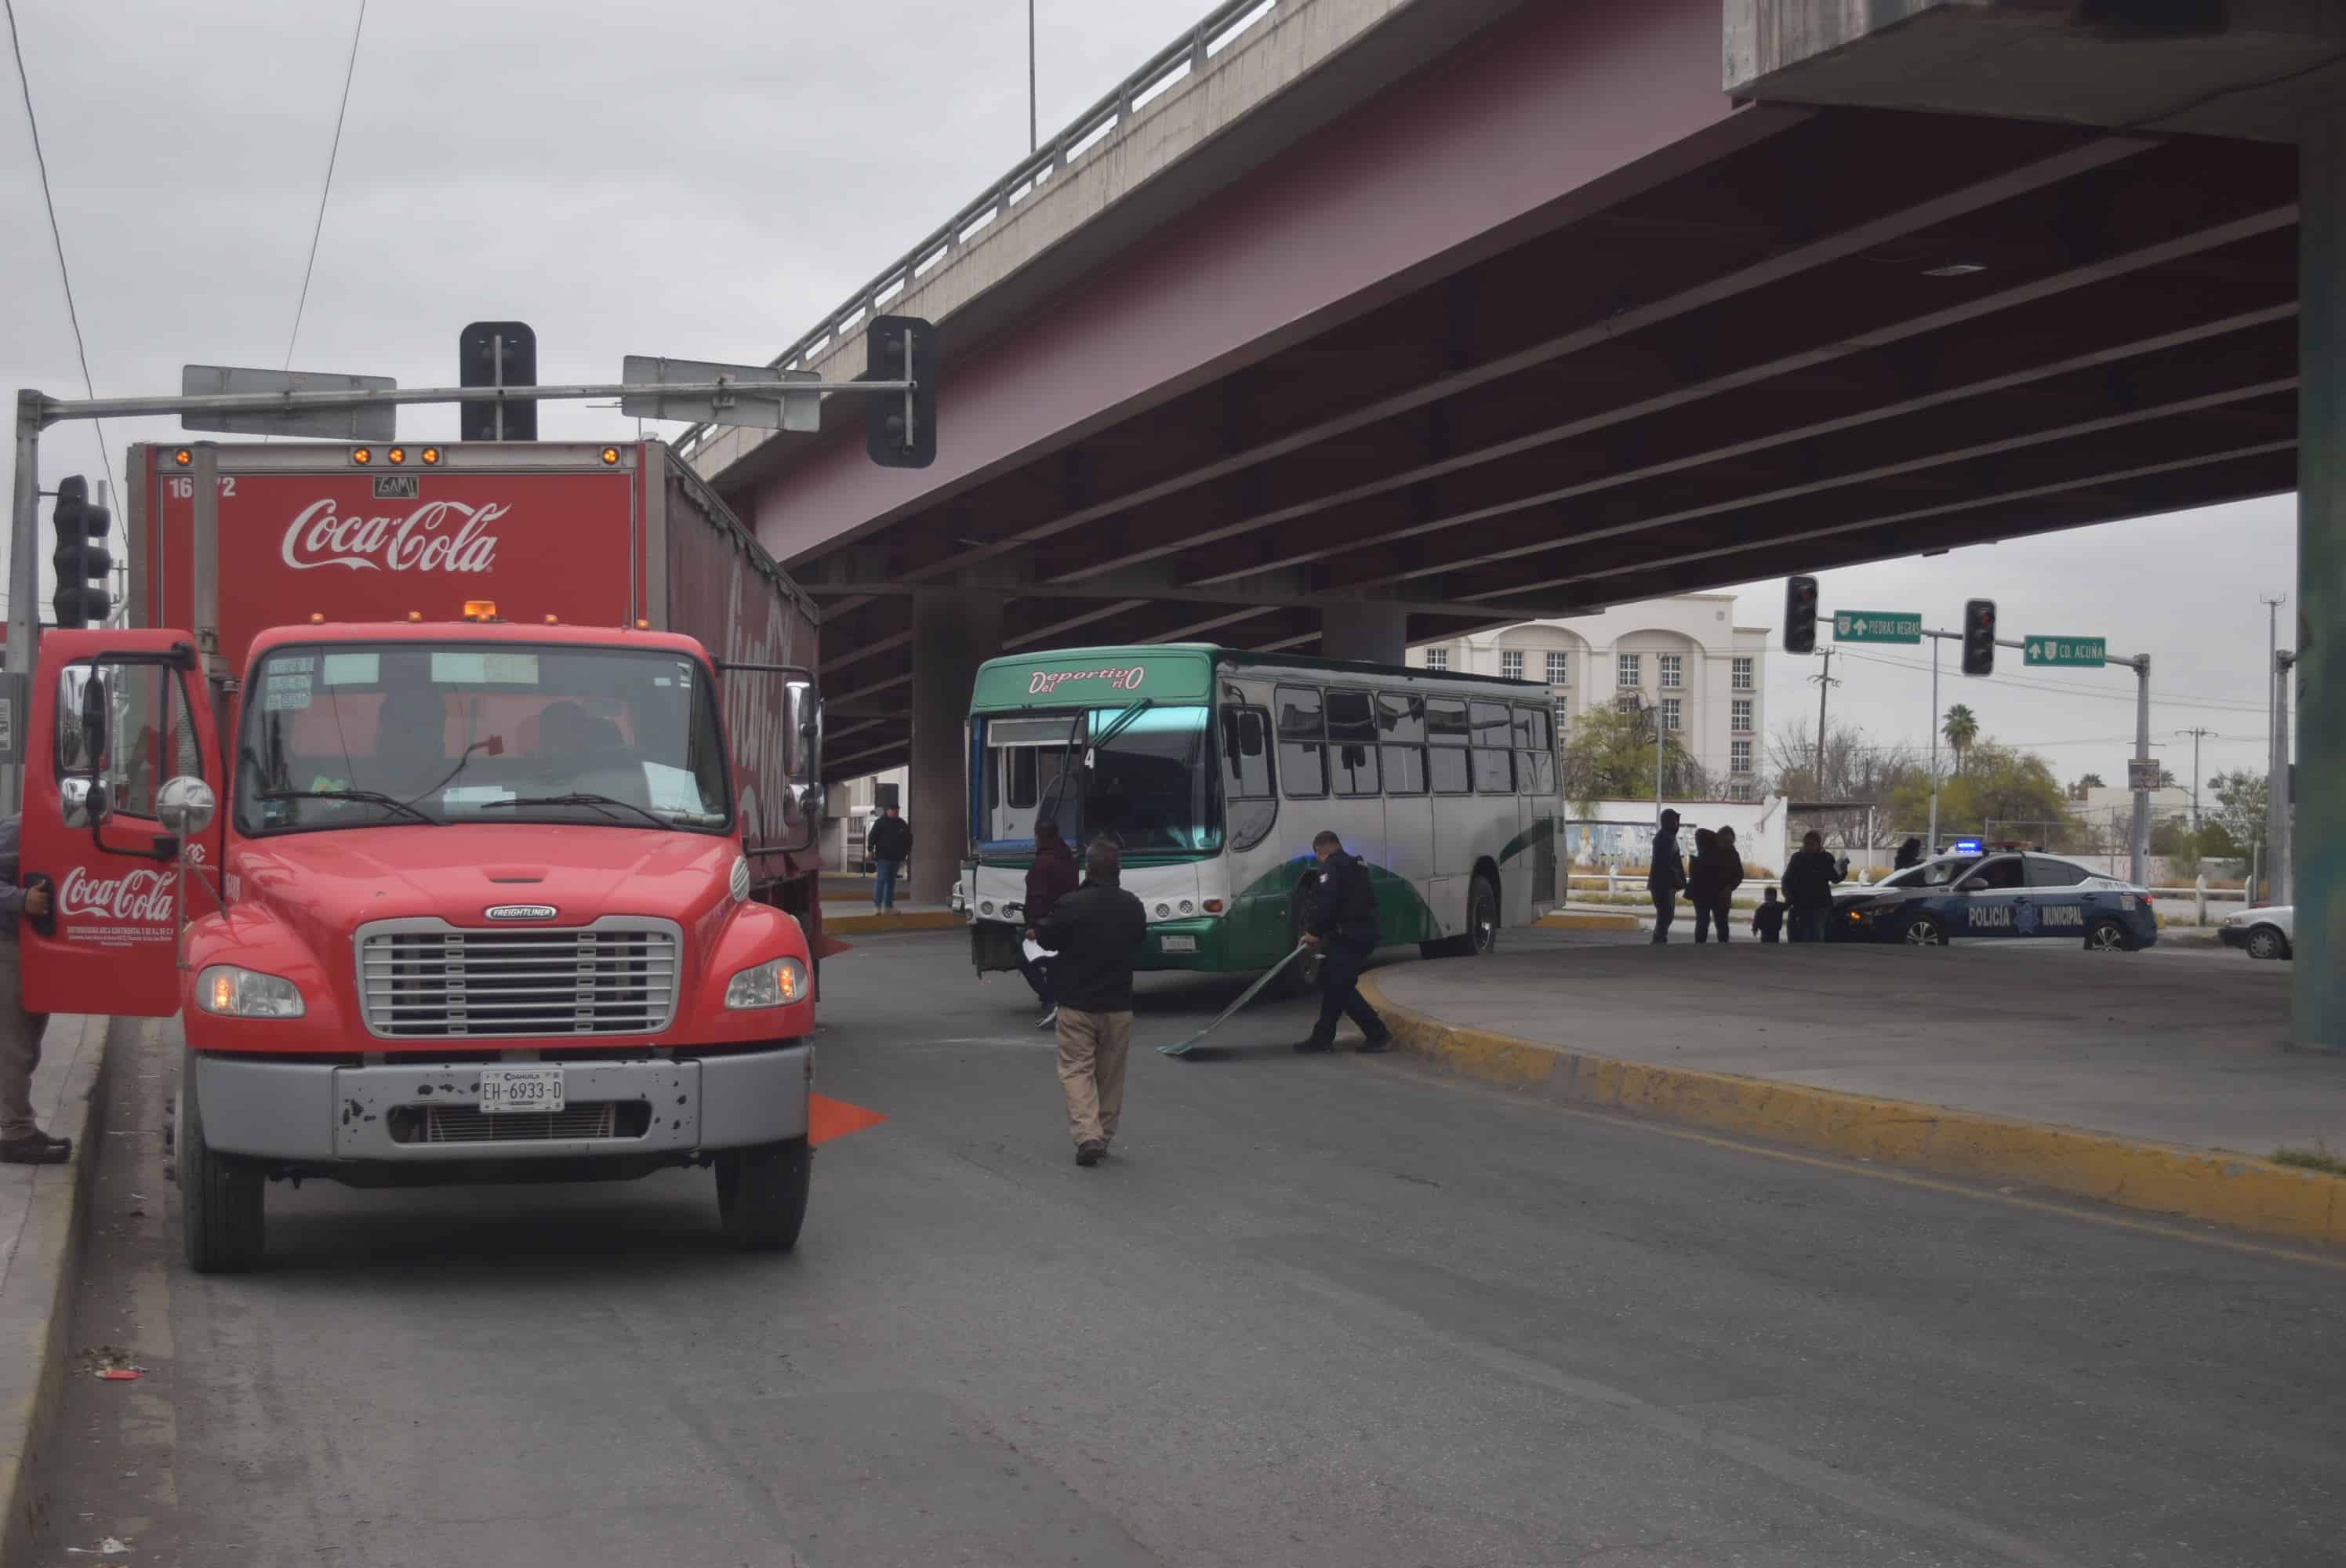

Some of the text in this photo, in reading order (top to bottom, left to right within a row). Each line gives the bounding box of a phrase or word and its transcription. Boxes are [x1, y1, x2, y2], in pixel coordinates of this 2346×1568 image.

[1868, 620, 1894, 634] PIEDRAS
[1897, 621, 1920, 636] NEGRAS
[2074, 642, 2103, 659] ACUÑA
[493, 908, 551, 917] FREIGHTLINER
[1969, 905, 2083, 927] POLICÍA MUNICIPAL
[483, 1081, 561, 1101] EH-6933-D
